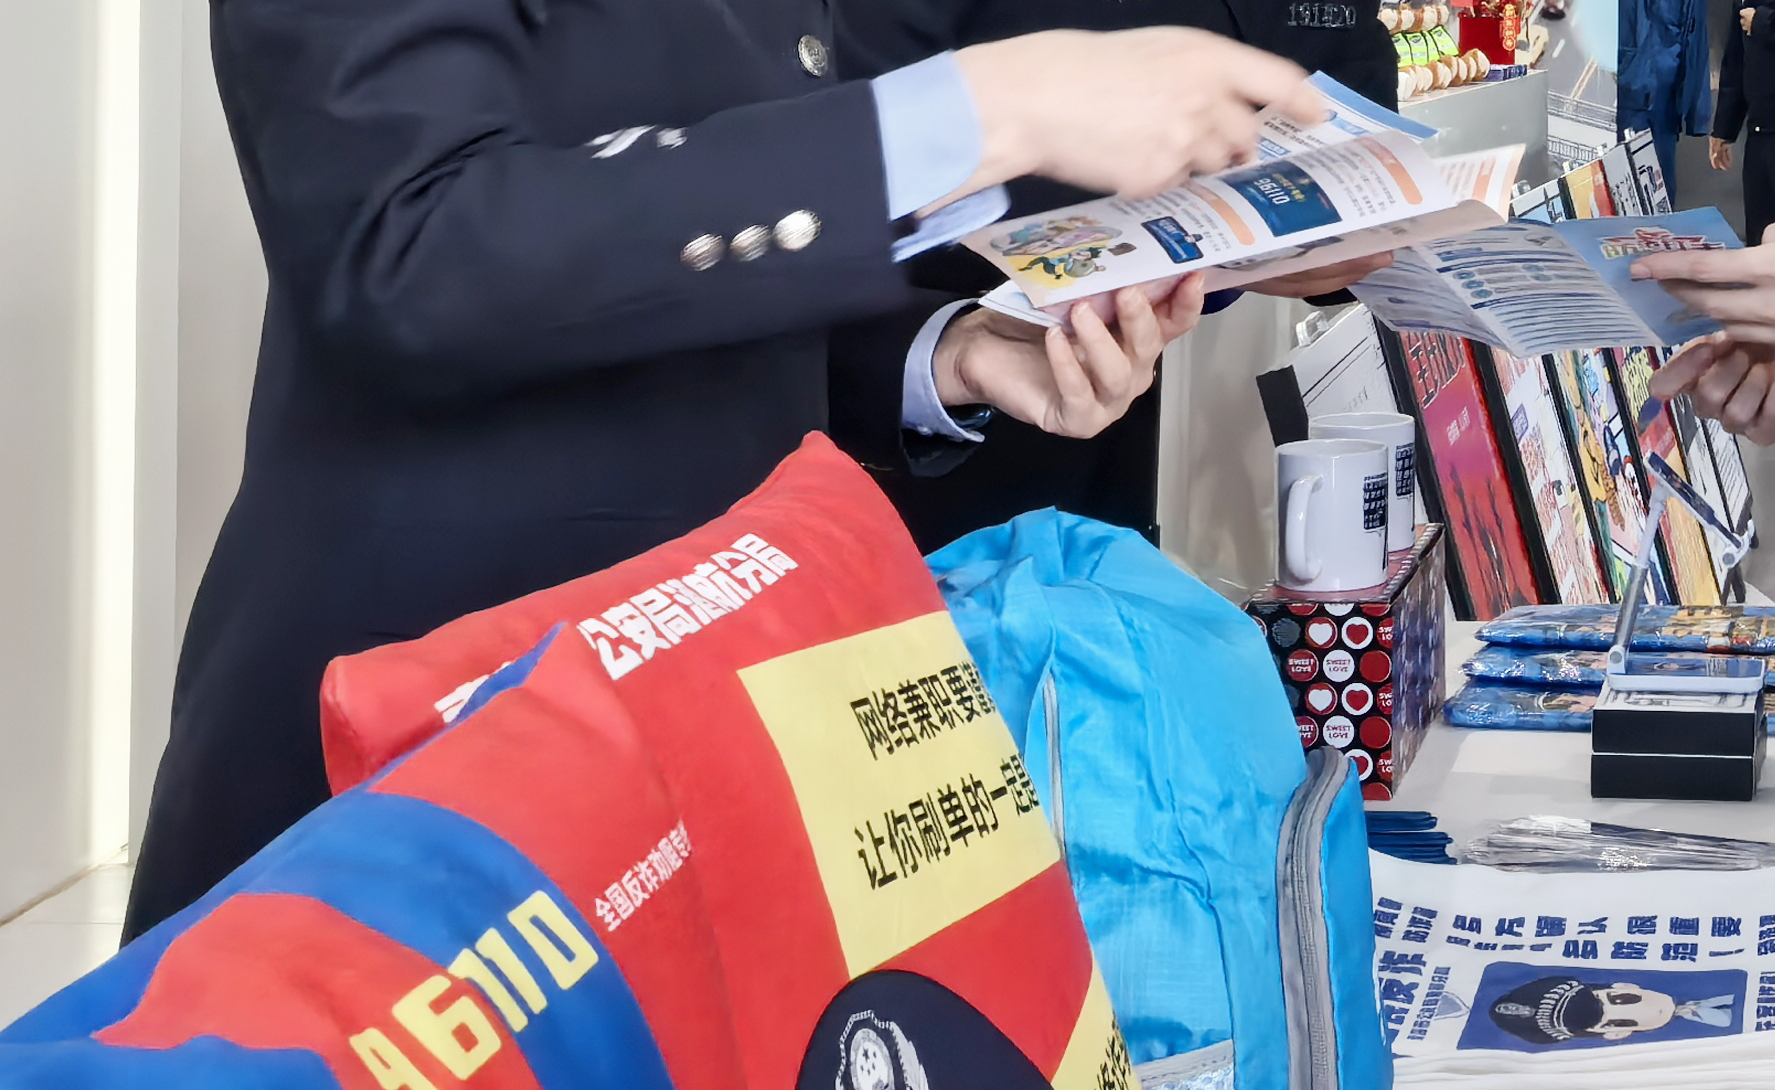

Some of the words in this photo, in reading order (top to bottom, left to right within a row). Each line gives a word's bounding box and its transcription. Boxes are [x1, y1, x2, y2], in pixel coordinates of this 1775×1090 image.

[1328, 731, 1349, 739] LOVE
[854, 753, 1041, 891] 让你刷单的一定是
